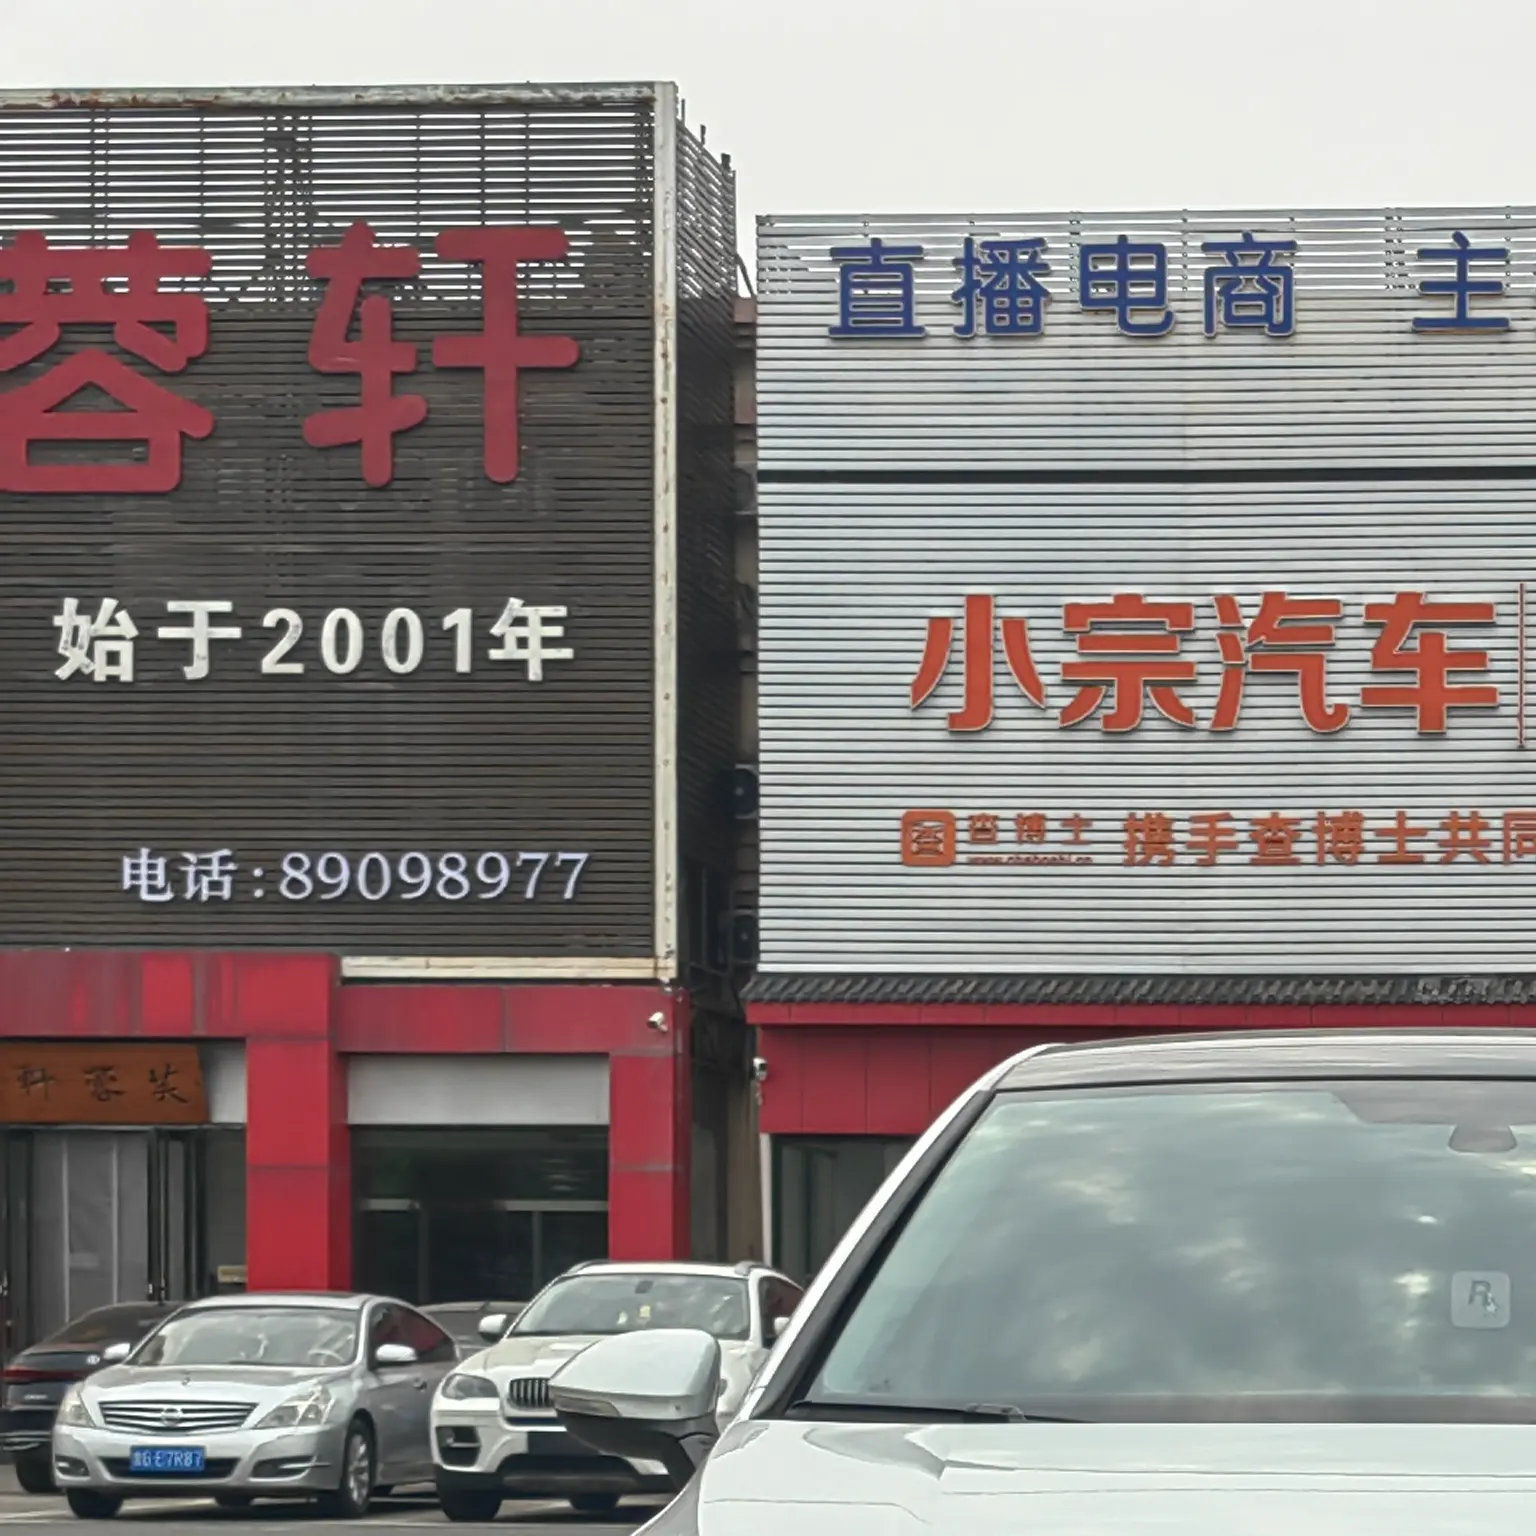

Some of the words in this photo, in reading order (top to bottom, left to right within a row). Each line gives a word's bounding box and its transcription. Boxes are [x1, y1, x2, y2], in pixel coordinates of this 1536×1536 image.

[827, 232, 1297, 339] 直播电商
[53, 597, 575, 681] 始于2001年
[910, 591, 1498, 735] 小宗汽车
